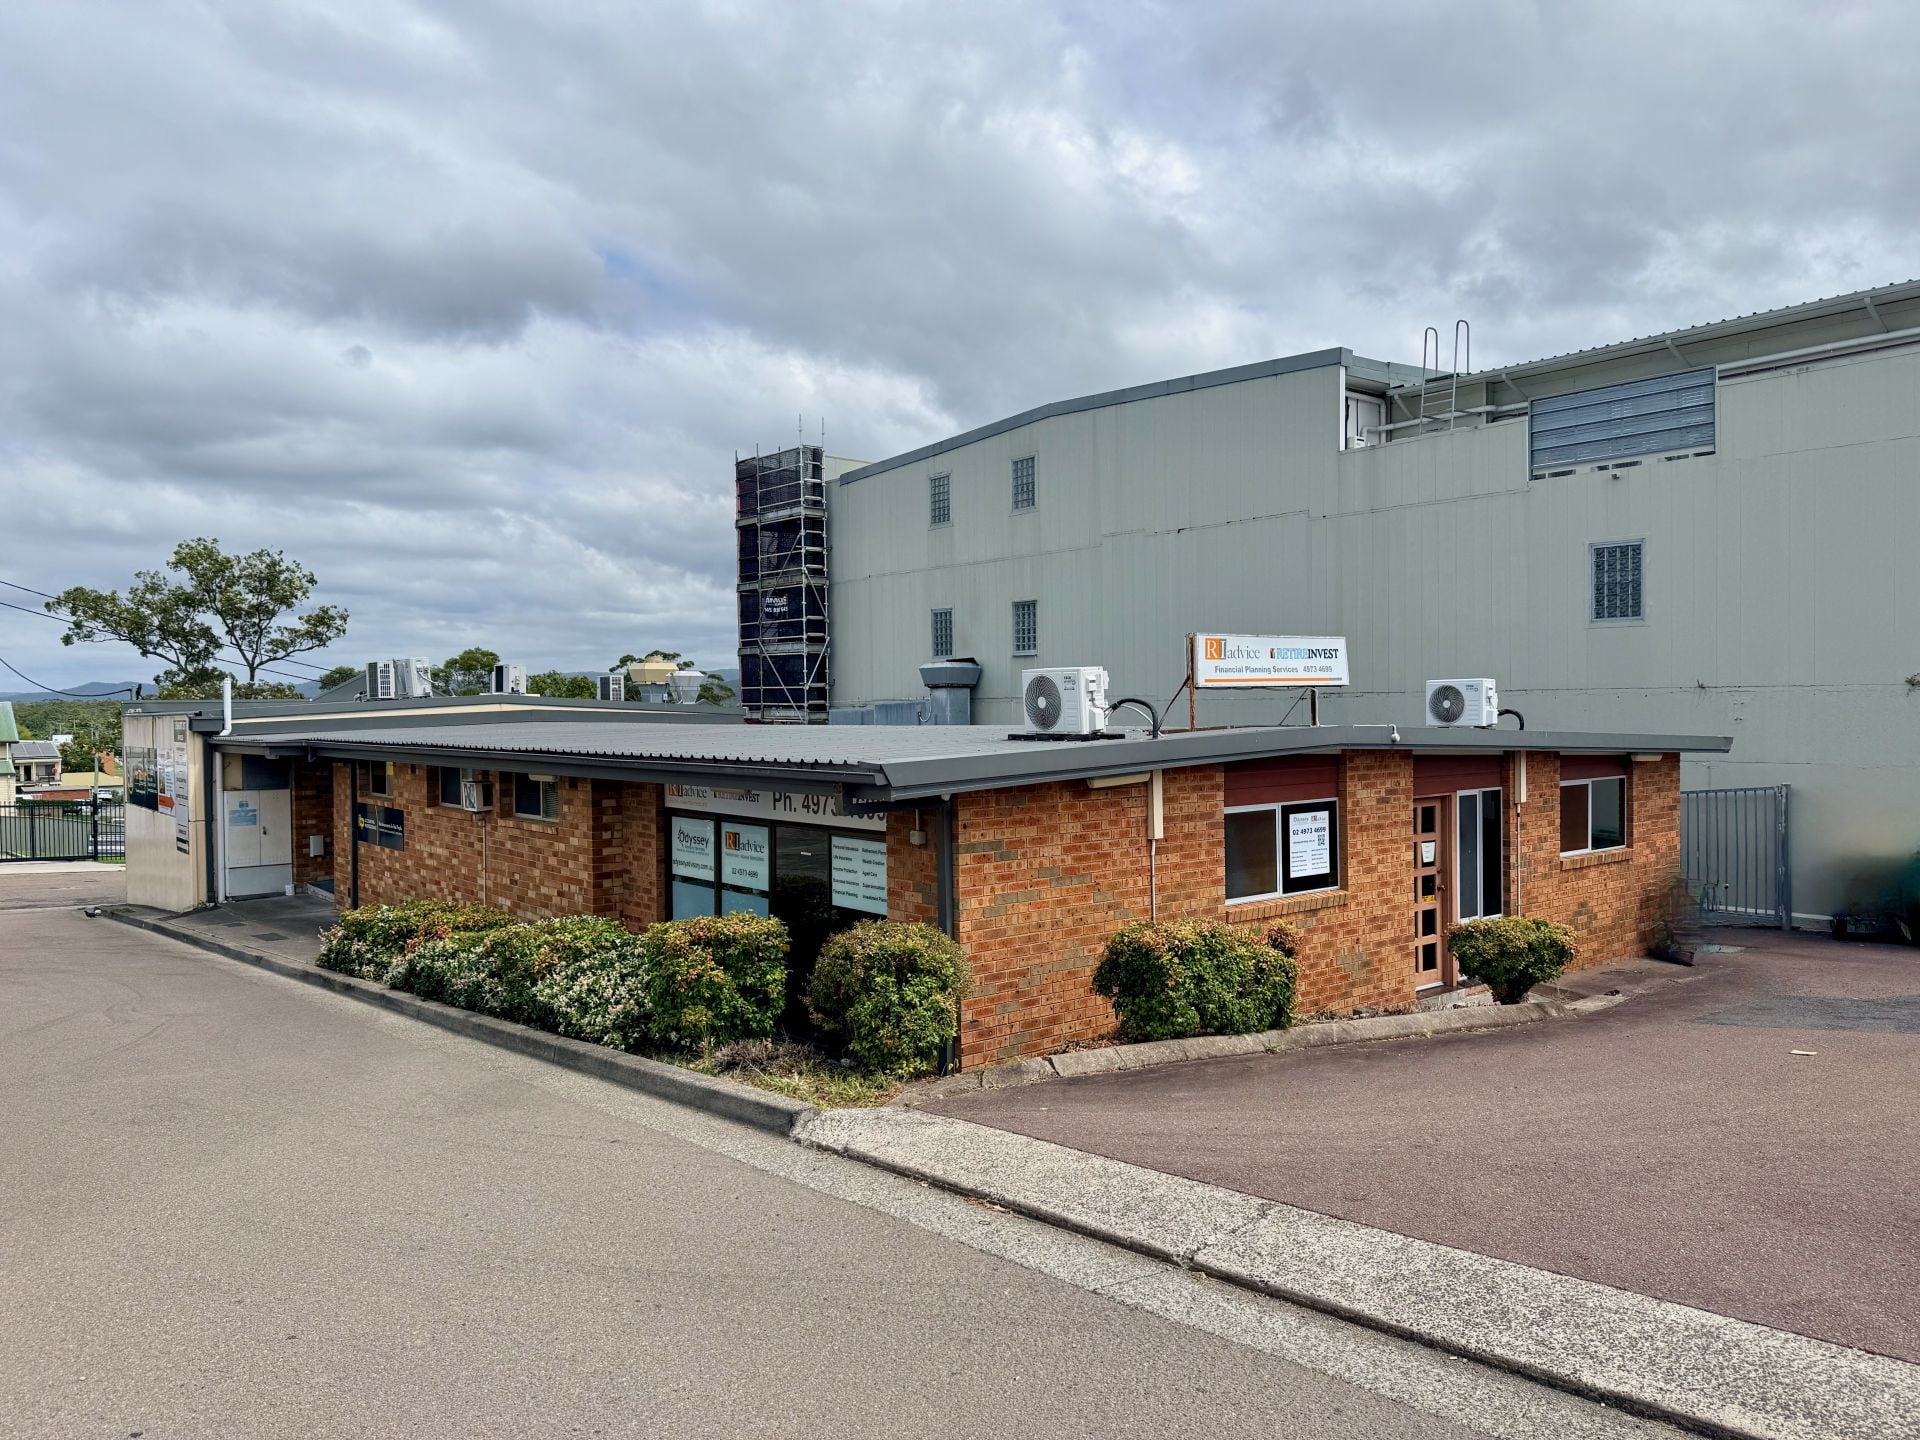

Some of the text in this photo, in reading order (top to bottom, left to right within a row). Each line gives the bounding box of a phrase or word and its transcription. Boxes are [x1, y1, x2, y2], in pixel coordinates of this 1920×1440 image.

[1227, 645, 1260, 659] advice
[1245, 665, 1271, 674] Planning
[1273, 665, 1298, 673] Services
[683, 785, 707, 798] advice
[773, 791, 797, 812] Ph.
[1300, 827, 1313, 835] 4973
[678, 829, 709, 848] Odyssey
[740, 840, 765, 853] advice
